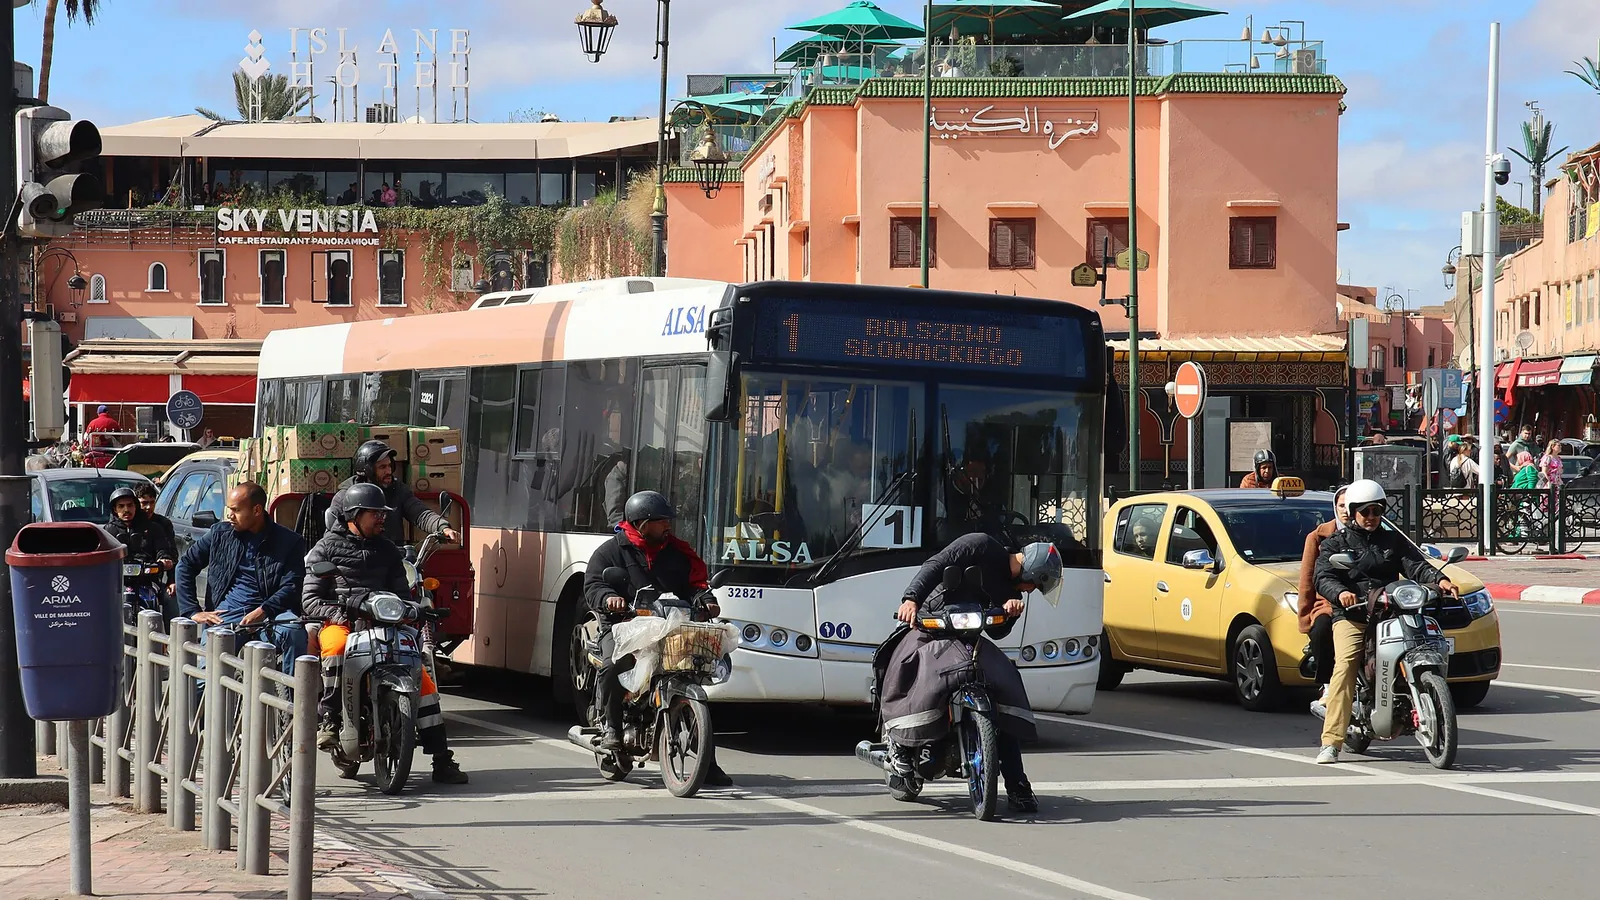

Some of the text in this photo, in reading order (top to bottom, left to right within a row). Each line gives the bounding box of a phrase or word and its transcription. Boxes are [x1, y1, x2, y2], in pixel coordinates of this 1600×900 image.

[288, 27, 472, 55] ISLANE
[289, 53, 472, 89] HÔTEL
[217, 208, 379, 233] SKY VENISIA
[661, 304, 706, 336] ALSA
[782, 313, 800, 352] 1
[865, 318, 1002, 344] BOLSZEWO
[844, 338, 1023, 367] SŁOWACKIEGO
[1281, 479, 1302, 487] TAXI
[884, 509, 904, 545] 1
[720, 538, 815, 564] ALSA
[41, 595, 81, 604] ARMA
[727, 587, 764, 599] 32821
[1380, 659, 1390, 707] BECANE
